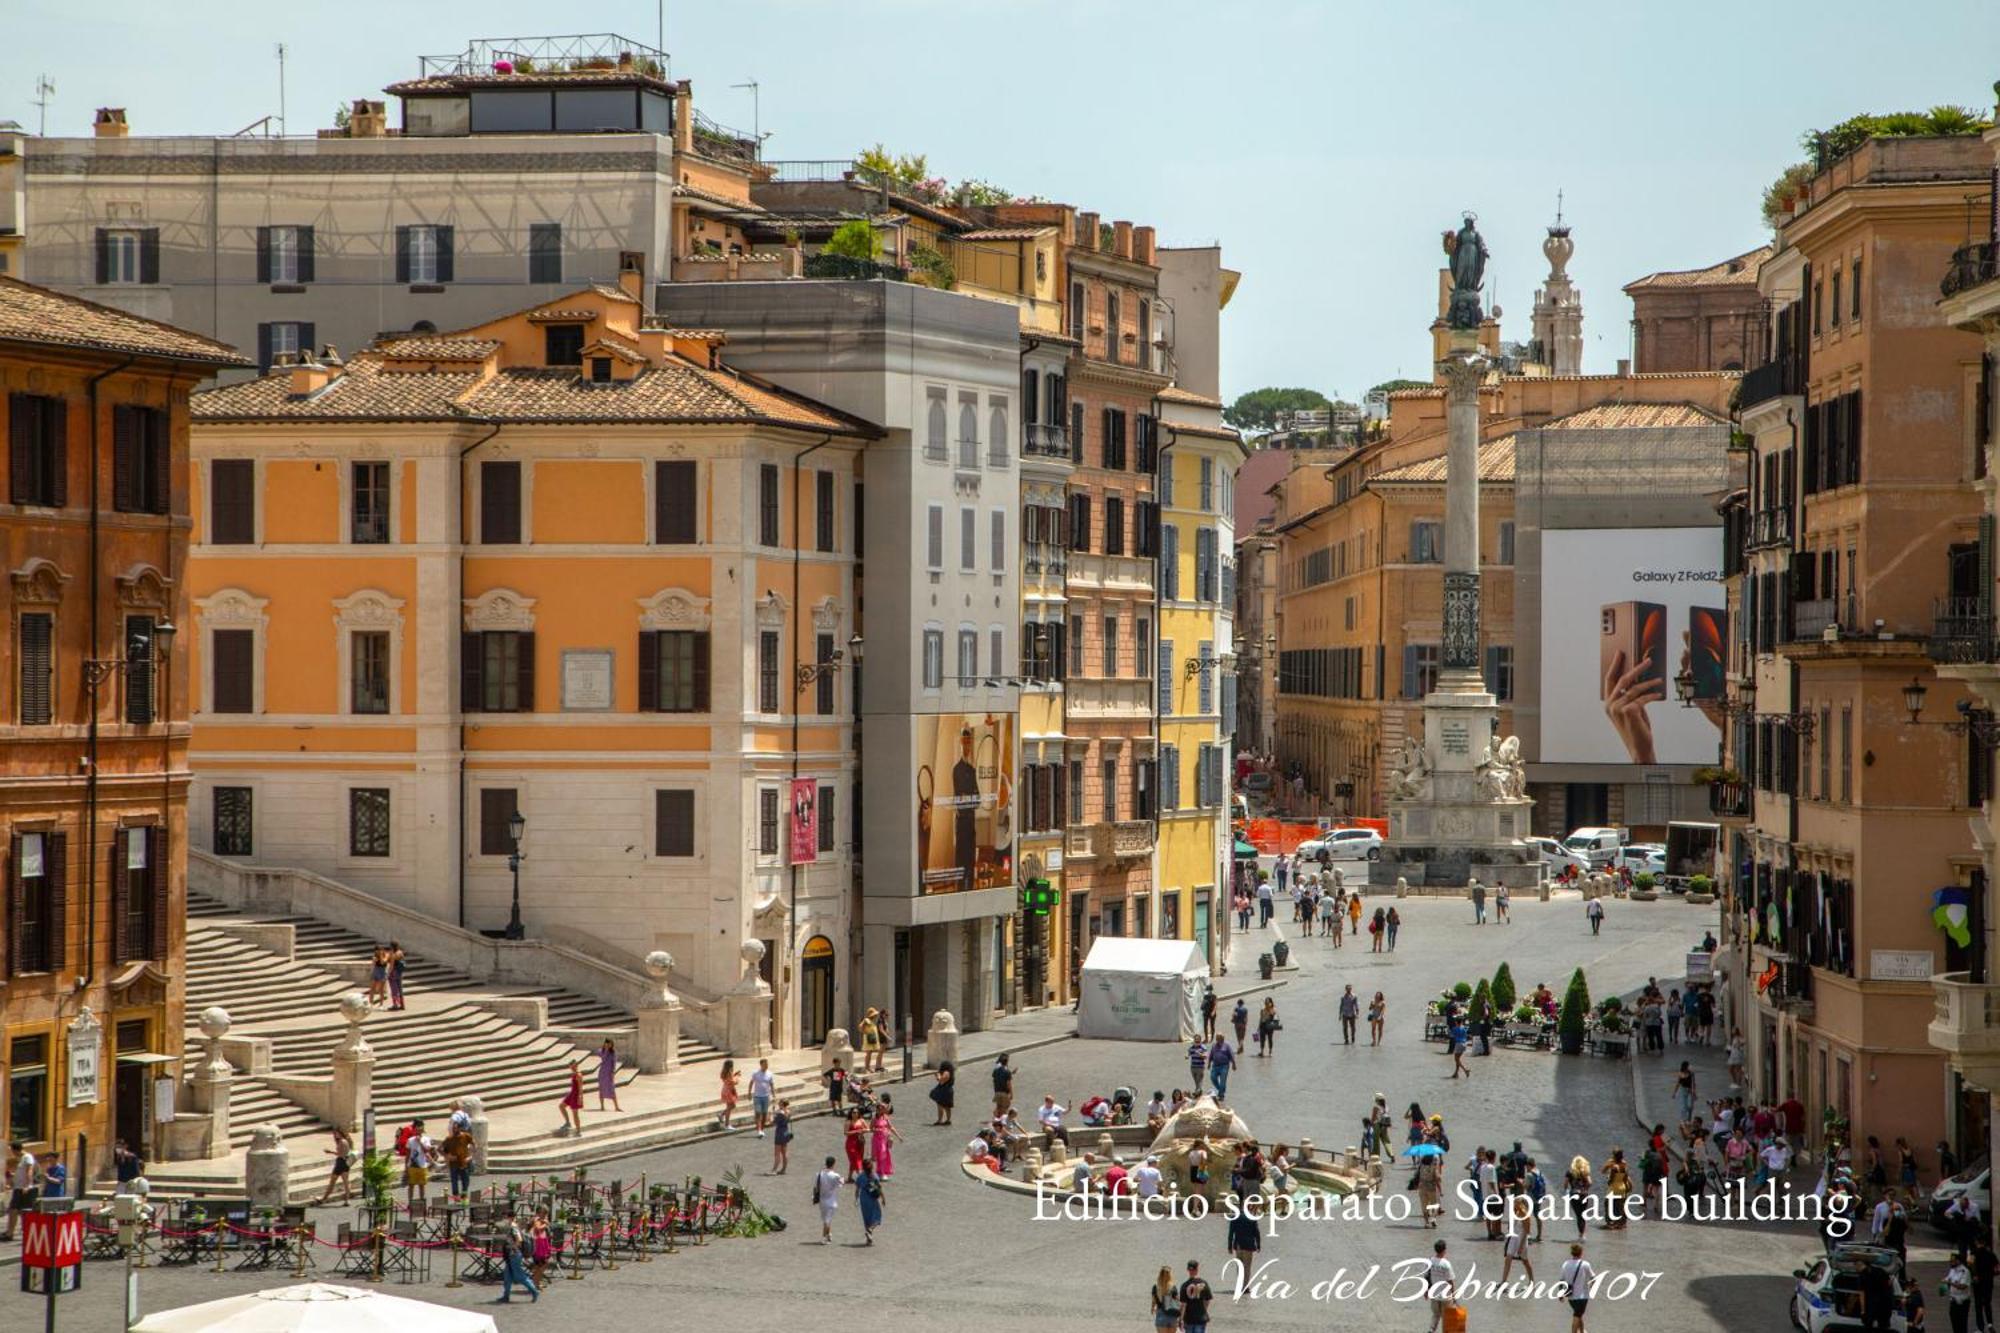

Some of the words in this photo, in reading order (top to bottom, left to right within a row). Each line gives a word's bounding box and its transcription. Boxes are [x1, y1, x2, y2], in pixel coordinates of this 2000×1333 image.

[1632, 571, 1676, 584] Galaxy
[1678, 571, 1685, 581] Z
[76, 1058, 90, 1071] TEA
[25, 1222, 51, 1257] M
[56, 1220, 80, 1257] M
